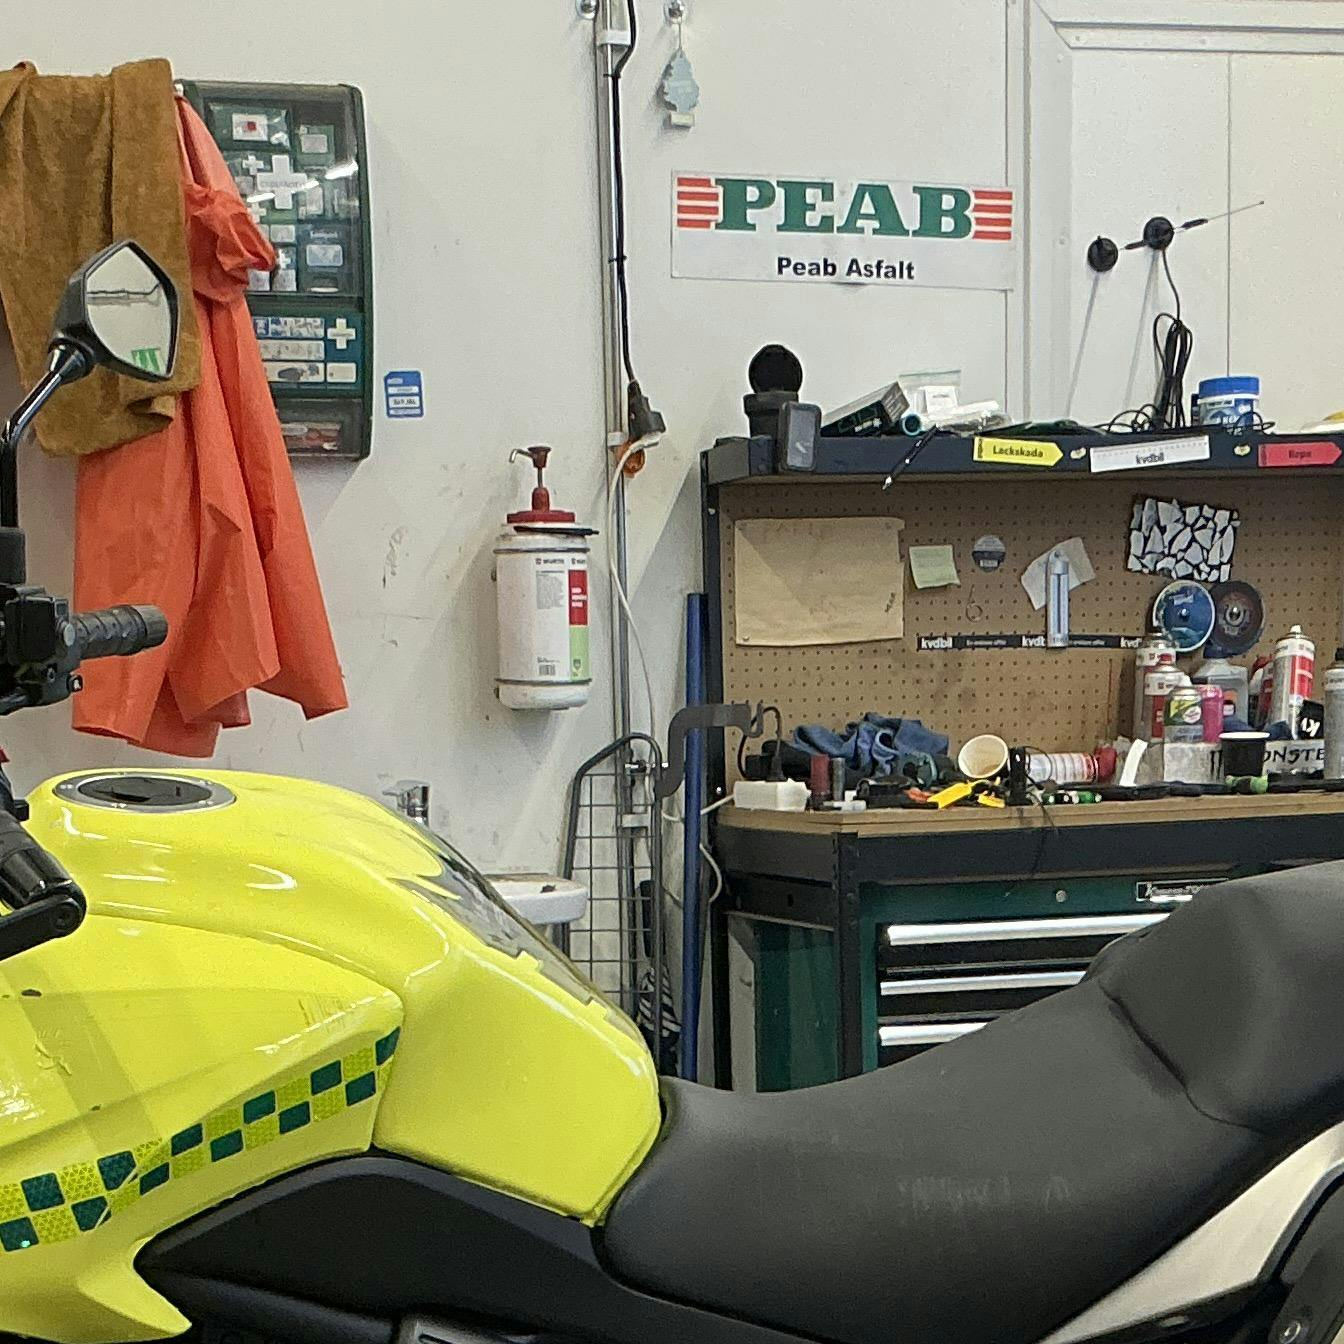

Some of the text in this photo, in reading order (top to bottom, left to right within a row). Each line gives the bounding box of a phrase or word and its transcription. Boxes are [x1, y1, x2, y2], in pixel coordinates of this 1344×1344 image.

[714, 178, 972, 239] PEAB
[777, 256, 915, 280] Peab Asfalt
[992, 445, 1044, 458] Lackskada
[1136, 452, 1165, 465] kvdbil
[921, 636, 953, 649] kvdbil
